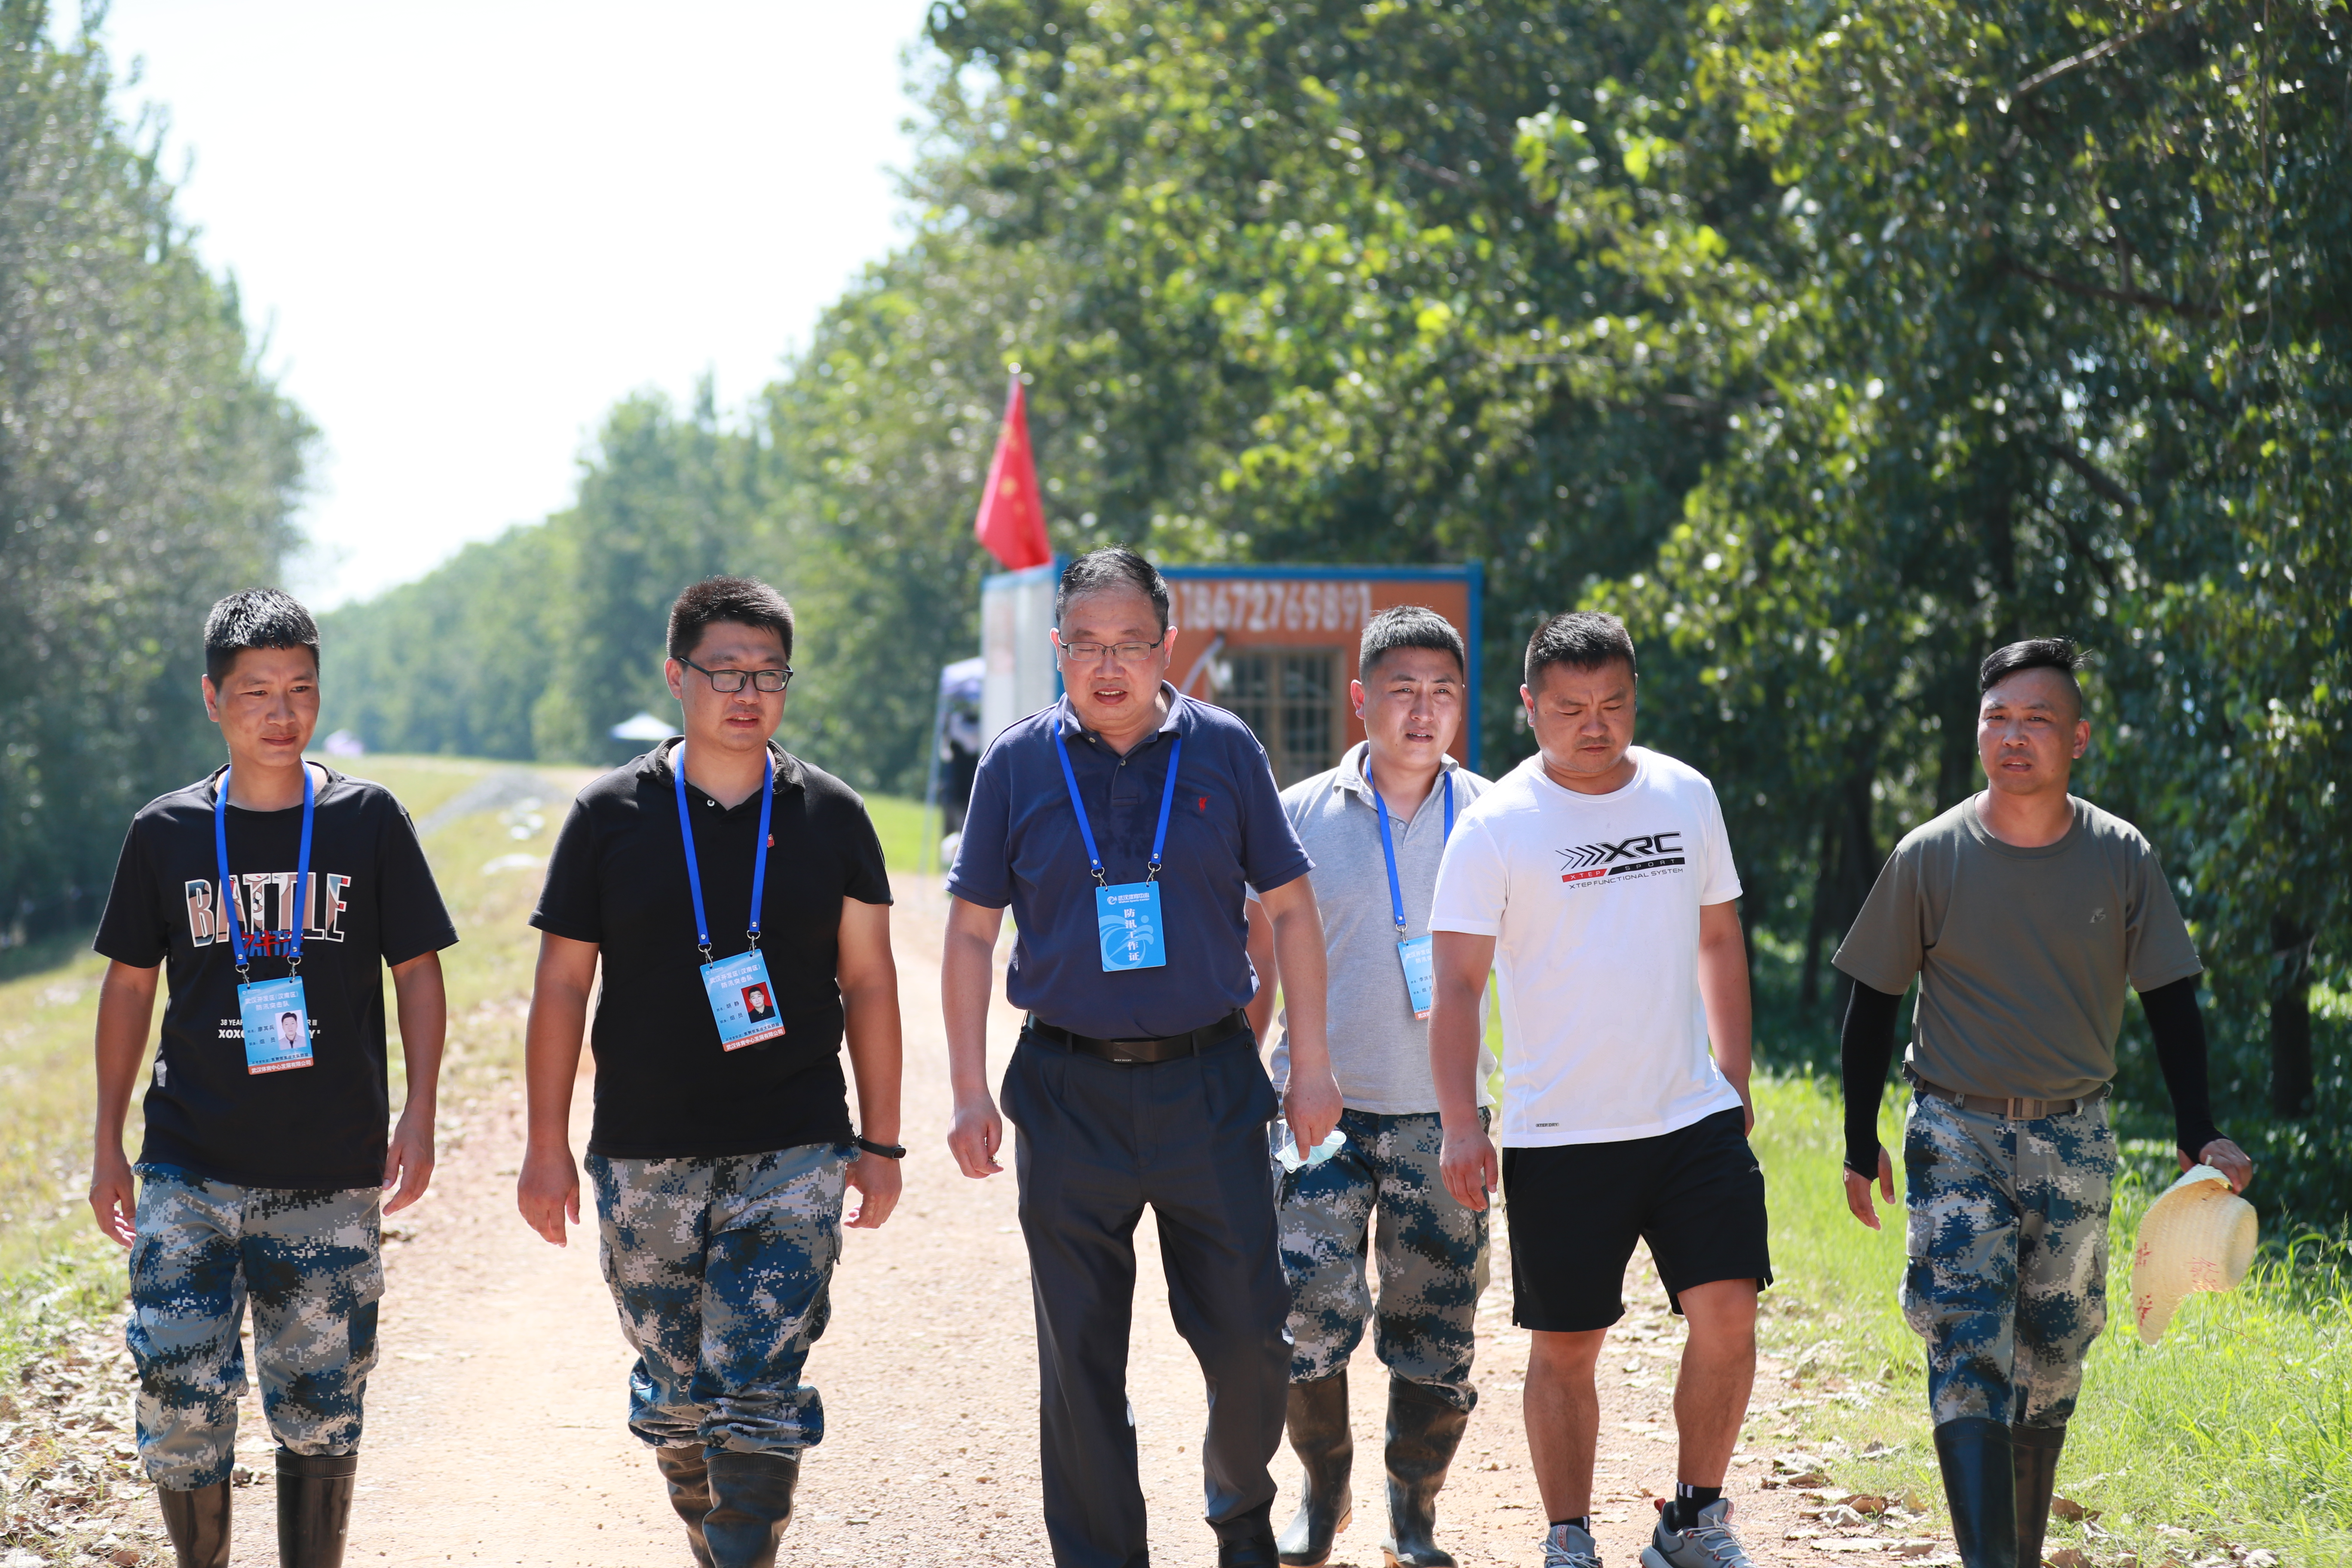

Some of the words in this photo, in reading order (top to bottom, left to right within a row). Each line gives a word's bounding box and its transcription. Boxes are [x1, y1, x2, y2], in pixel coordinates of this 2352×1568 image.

[1596, 831, 1684, 864] XRC
[1569, 882, 1592, 890] XTEP
[1594, 872, 1649, 886] FUNCTIONAL
[1651, 868, 1684, 876] SYSTEM
[1570, 871, 1601, 879] XTEP
[1625, 859, 1675, 870] SPORT
[185, 872, 351, 947] BATTLE
[1124, 908, 1140, 961] 防汛工作证
[721, 974, 753, 989] 防汛突击队
[256, 1001, 290, 1011] 防汛突击队
[726, 1029, 783, 1050] 武汉体育中心发展有限公司
[251, 1060, 311, 1074] 武汉体育中心发展有限公司
